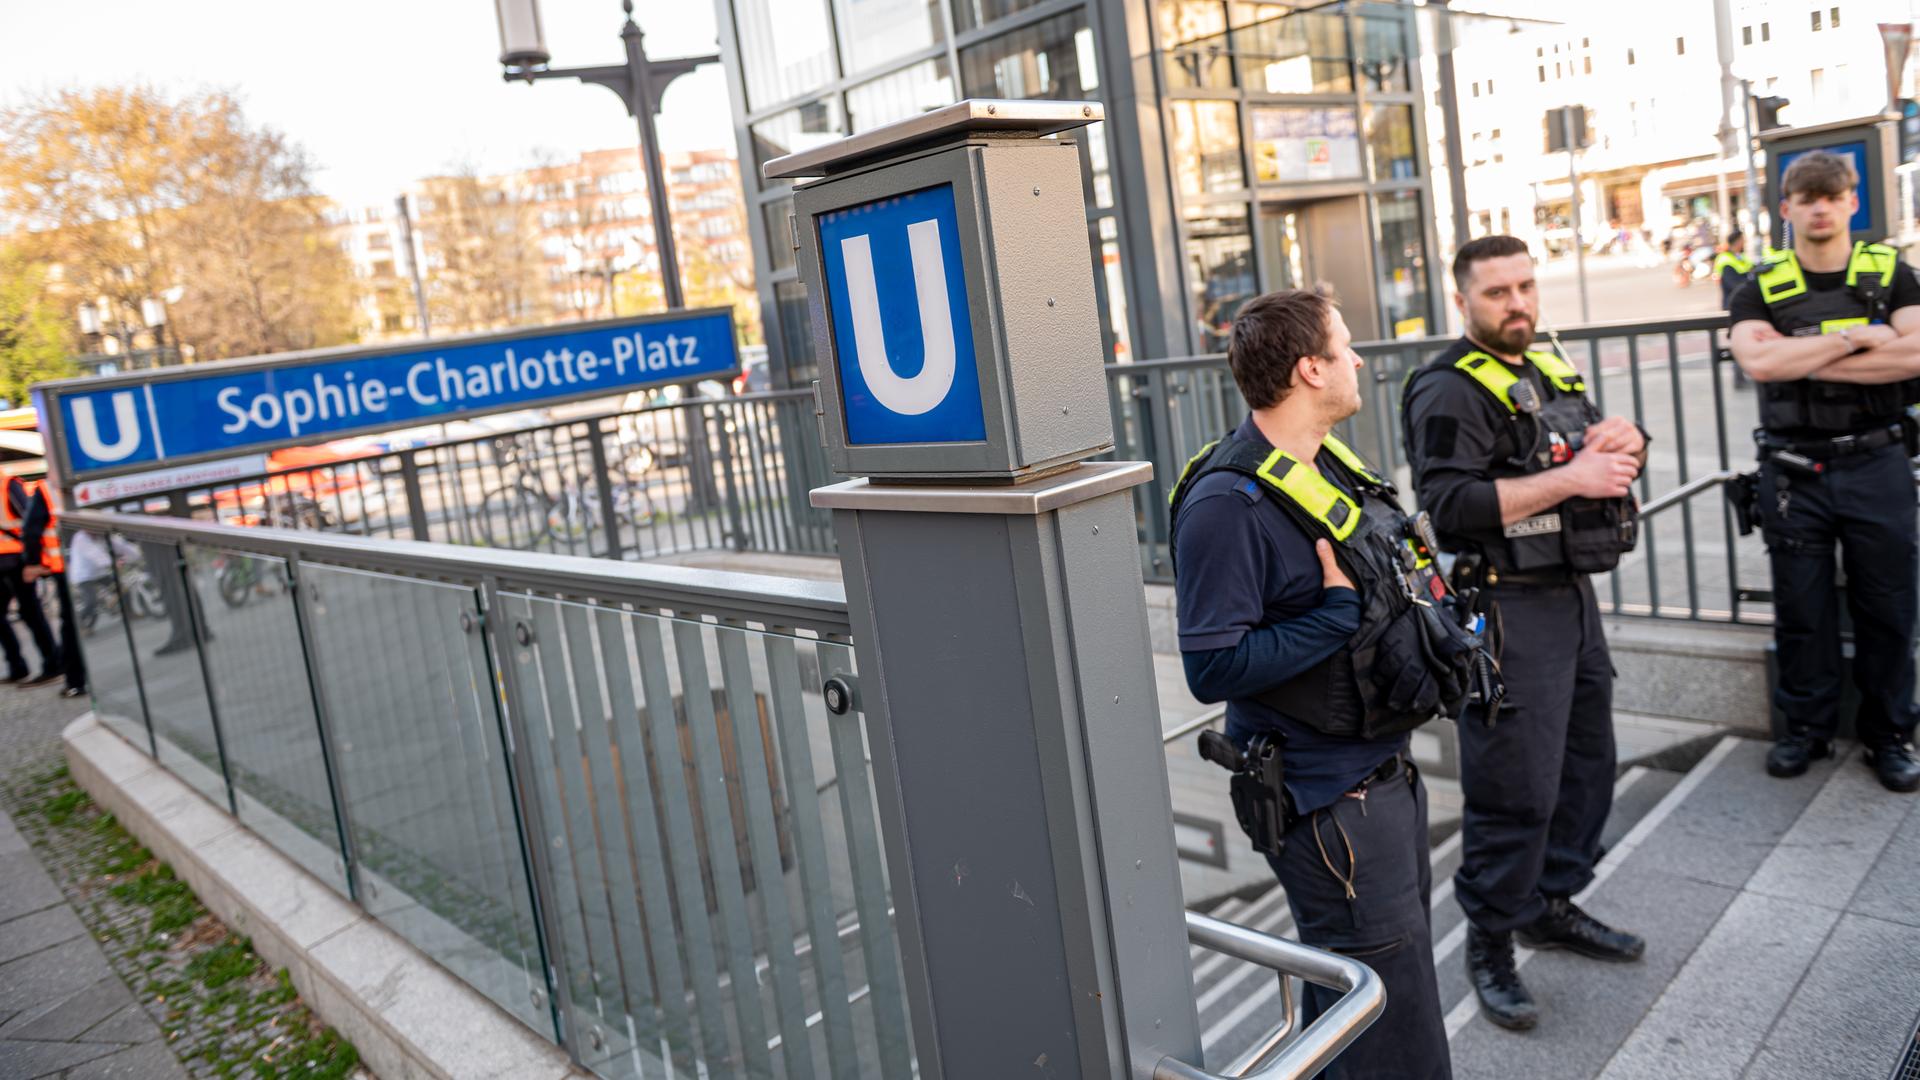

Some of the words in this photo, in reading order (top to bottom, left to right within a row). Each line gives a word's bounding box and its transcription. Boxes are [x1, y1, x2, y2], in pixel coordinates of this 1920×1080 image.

[70, 391, 141, 462] U
[217, 331, 700, 437] Sophie-Charlotte-Platz
[841, 218, 956, 416] U
